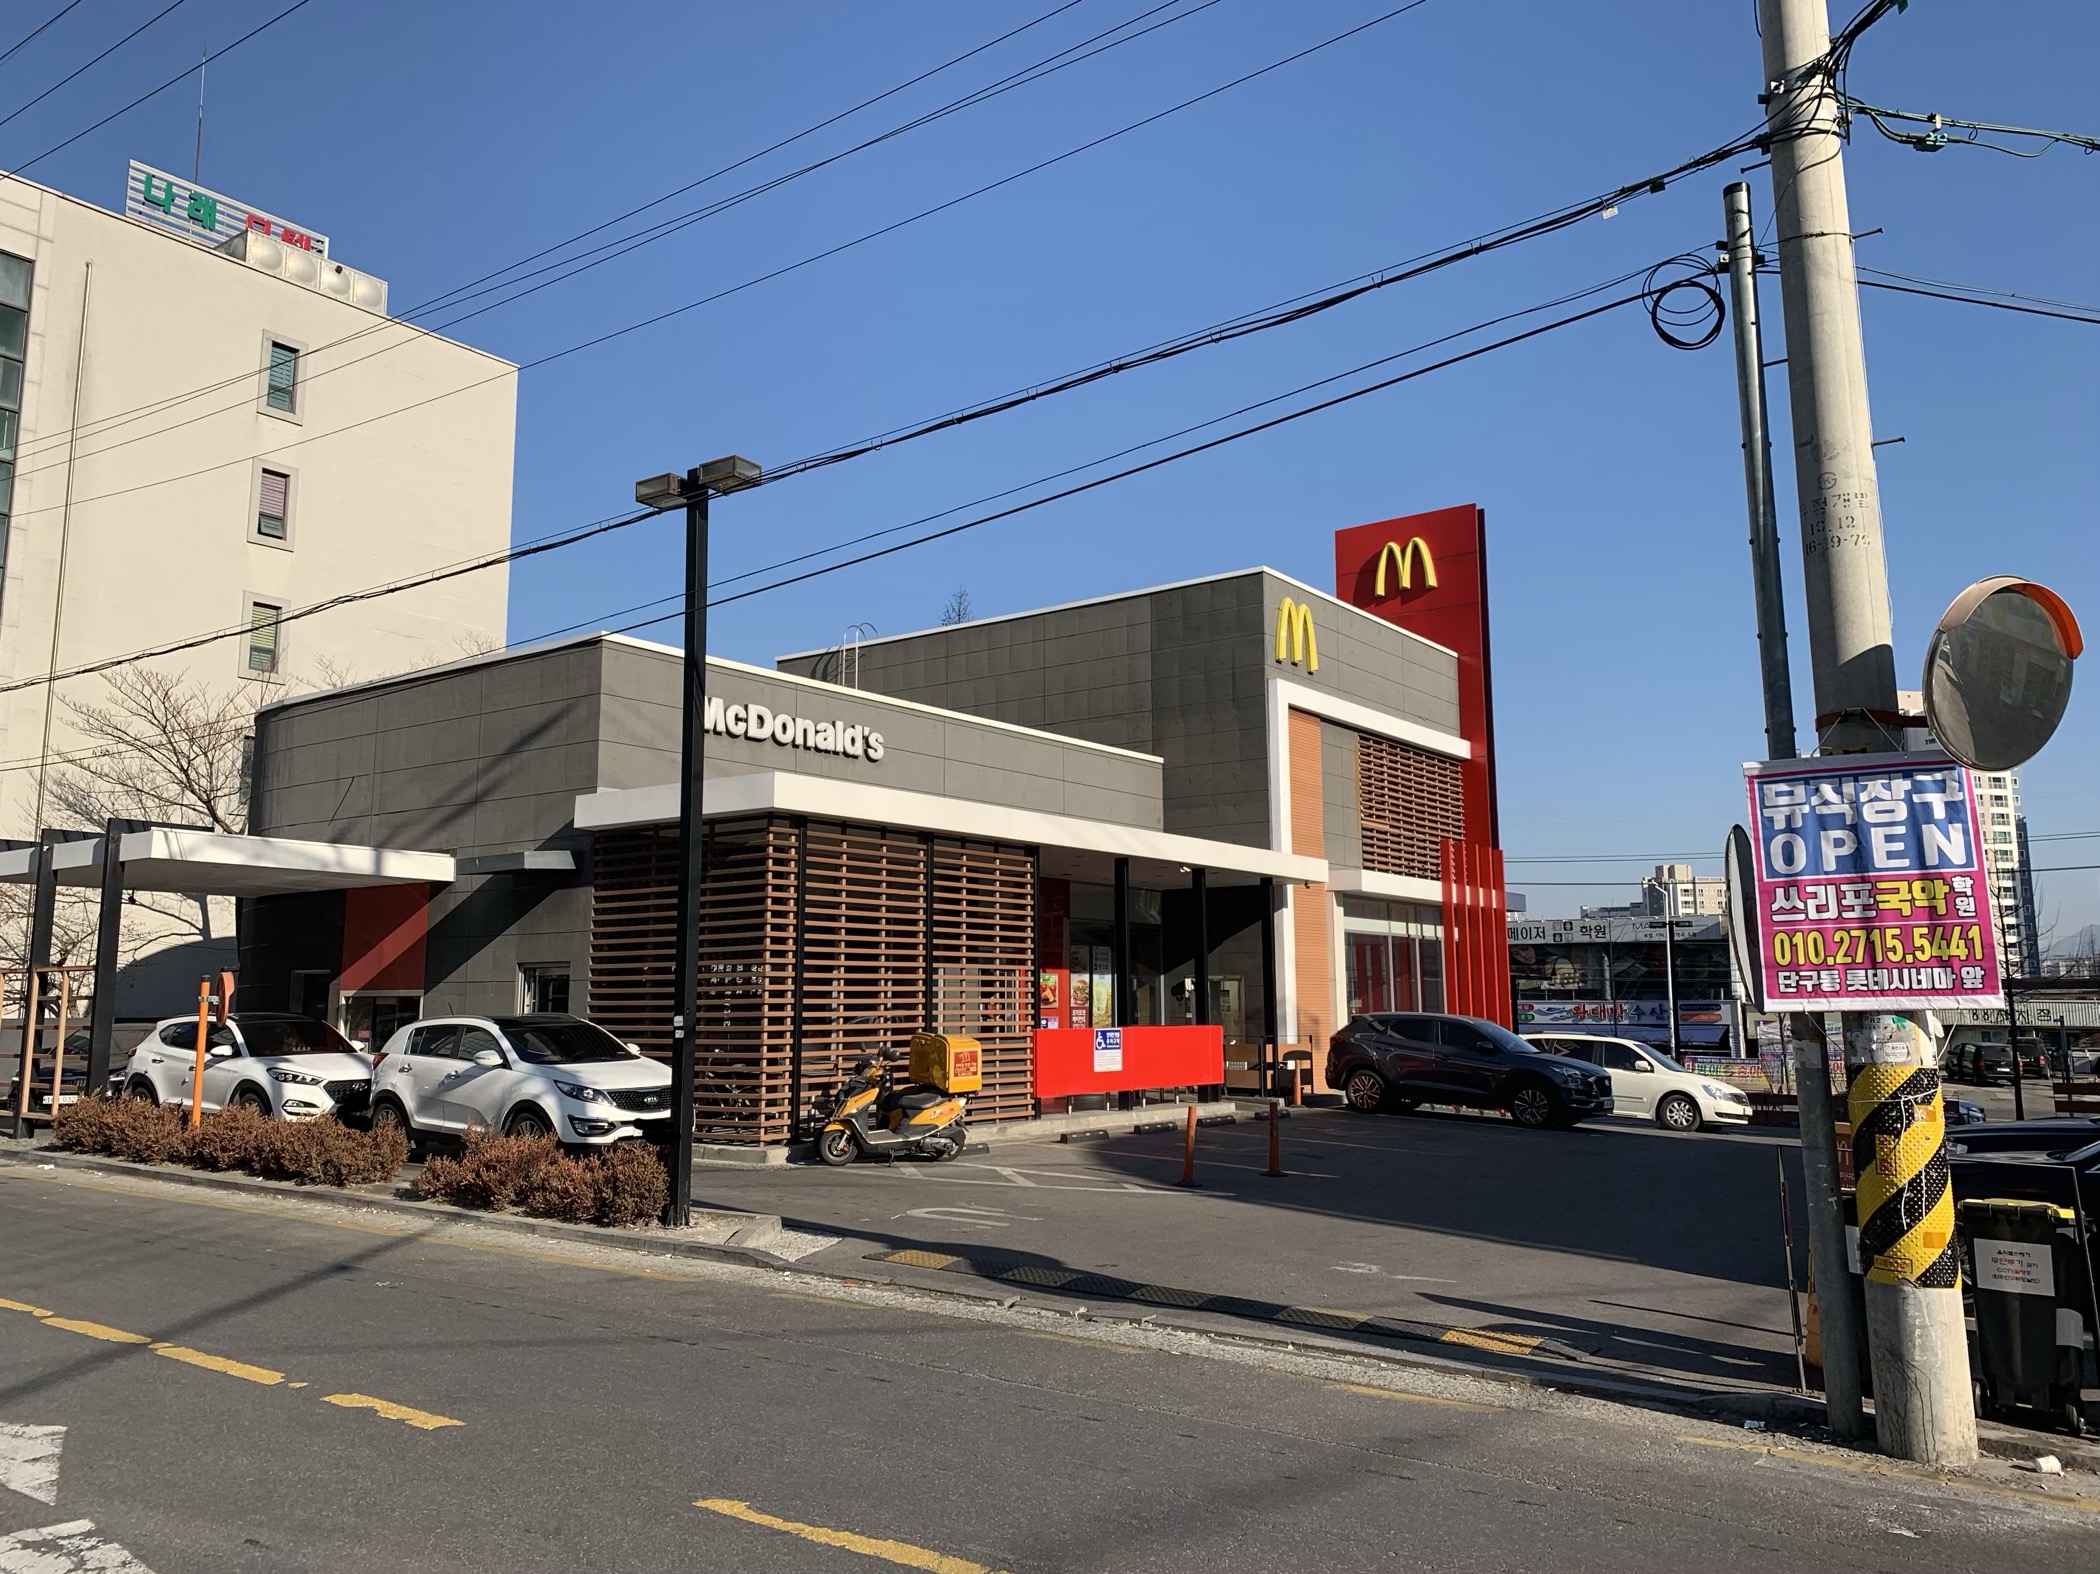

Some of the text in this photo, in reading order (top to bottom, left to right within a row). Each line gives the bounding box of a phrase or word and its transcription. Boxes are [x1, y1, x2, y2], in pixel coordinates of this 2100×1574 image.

[143, 172, 217, 231] 나래
[704, 694, 885, 761] McDonald's
[1763, 769, 1963, 830] 뮤직장구
[1770, 823, 1967, 875] OPEN
[1579, 924, 1607, 939] 학원
[1773, 924, 1984, 966] 010.2715.5441
[1778, 966, 1985, 993] 단구동 롯데시네마 앞
